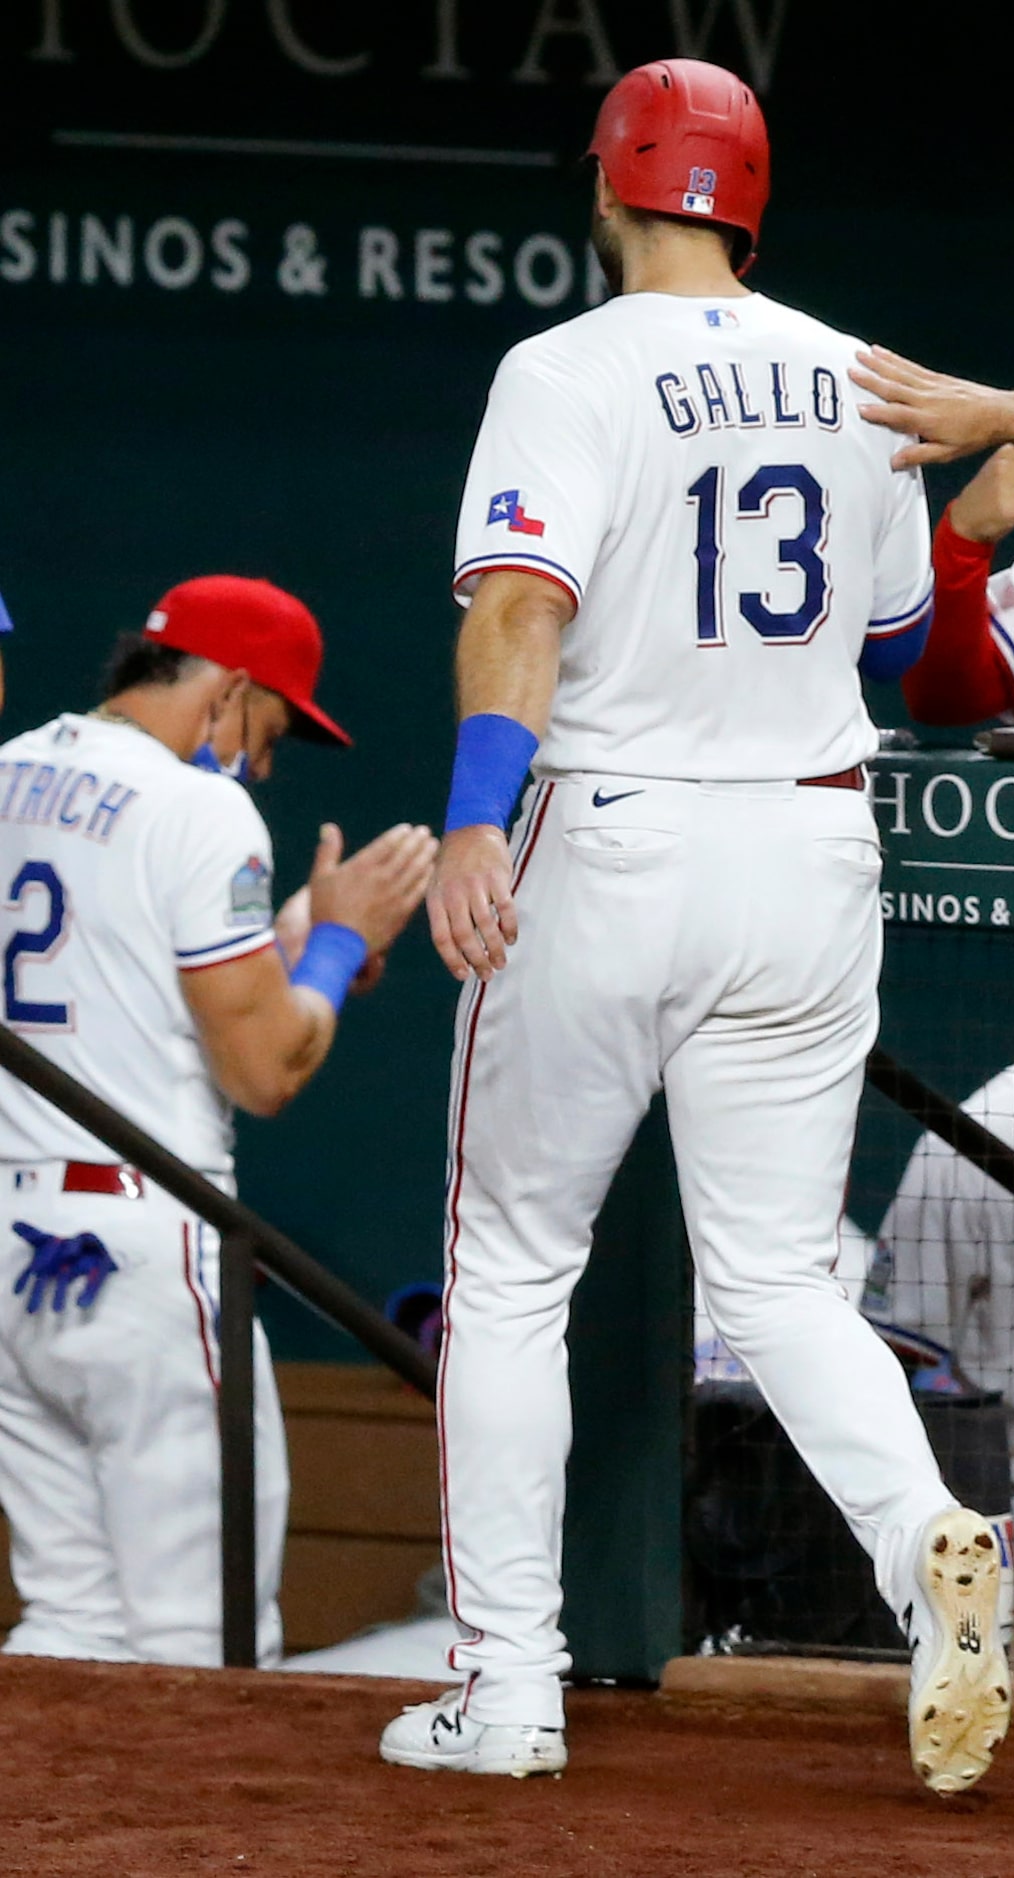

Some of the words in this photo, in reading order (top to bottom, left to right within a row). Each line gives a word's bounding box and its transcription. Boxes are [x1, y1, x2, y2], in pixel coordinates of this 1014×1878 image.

[688, 166, 717, 195] 13
[277, 221, 328, 296] &
[357, 226, 606, 308] RESO
[655, 361, 843, 439] GALLO
[685, 463, 833, 648] 13
[0, 760, 142, 847] TRICH
[0, 860, 76, 1034] 2
[880, 890, 981, 925] SINOS
[989, 896, 1011, 927] &
